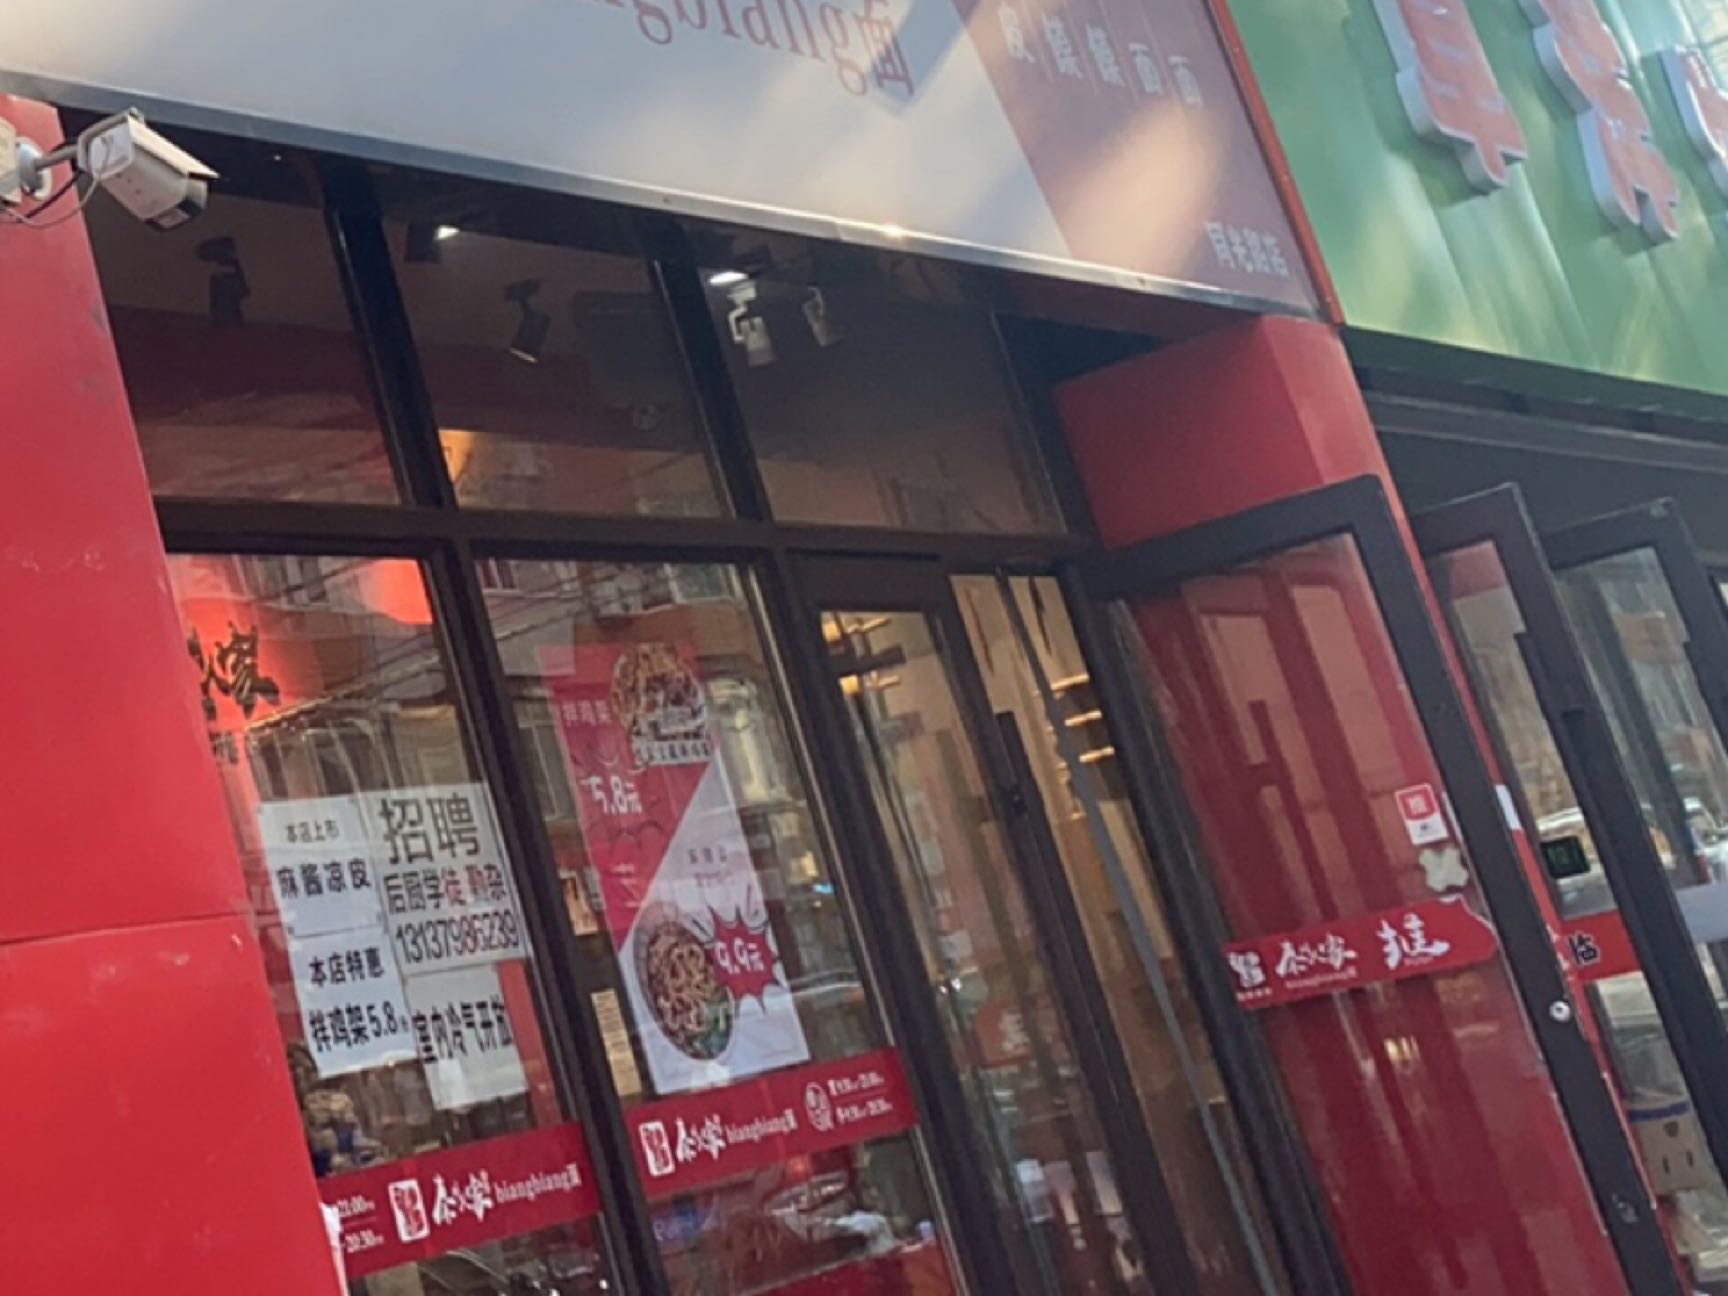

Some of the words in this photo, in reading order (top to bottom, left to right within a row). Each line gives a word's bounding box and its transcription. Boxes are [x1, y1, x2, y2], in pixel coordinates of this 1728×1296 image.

[380, 792, 481, 865] 招聘
[275, 857, 373, 899] 麻酱凉皮
[308, 947, 385, 987] 本店特惠
